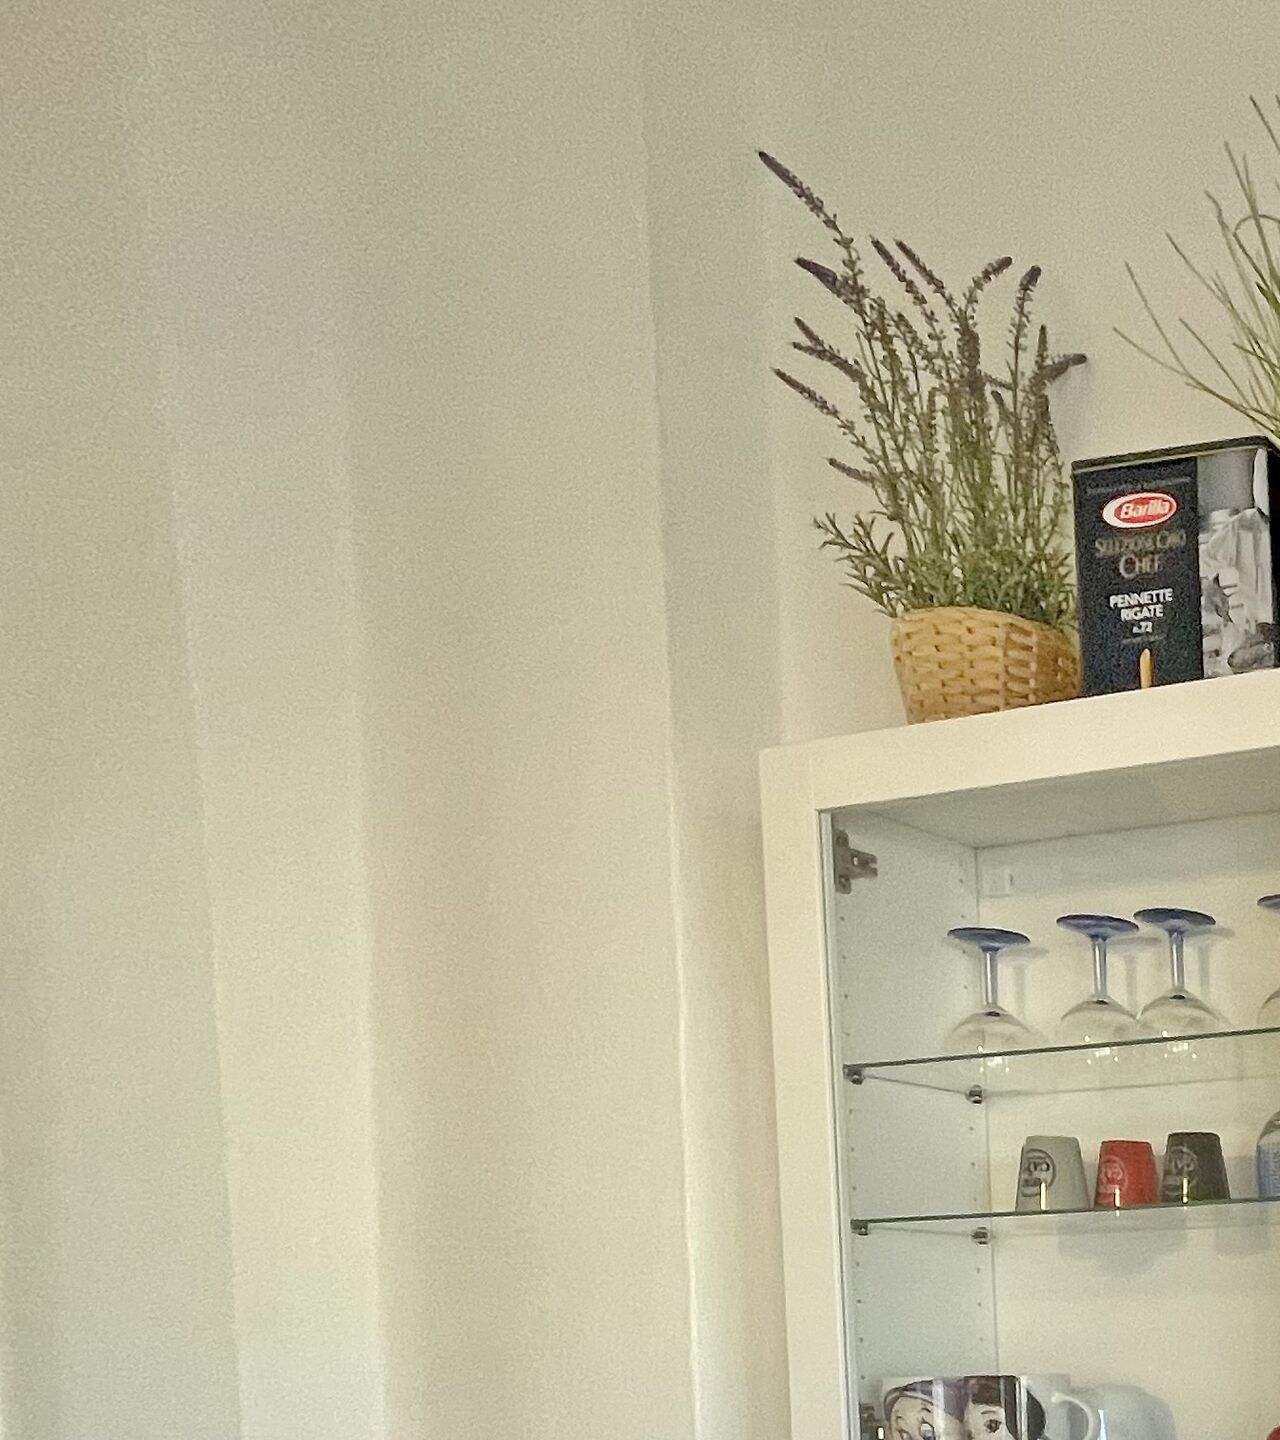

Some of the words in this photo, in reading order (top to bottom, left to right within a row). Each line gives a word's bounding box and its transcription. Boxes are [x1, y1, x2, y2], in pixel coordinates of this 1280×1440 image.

[1119, 500, 1172, 520] Barilla
[1109, 588, 1174, 609] PENNETTE
[1120, 604, 1164, 622] RIGATE
